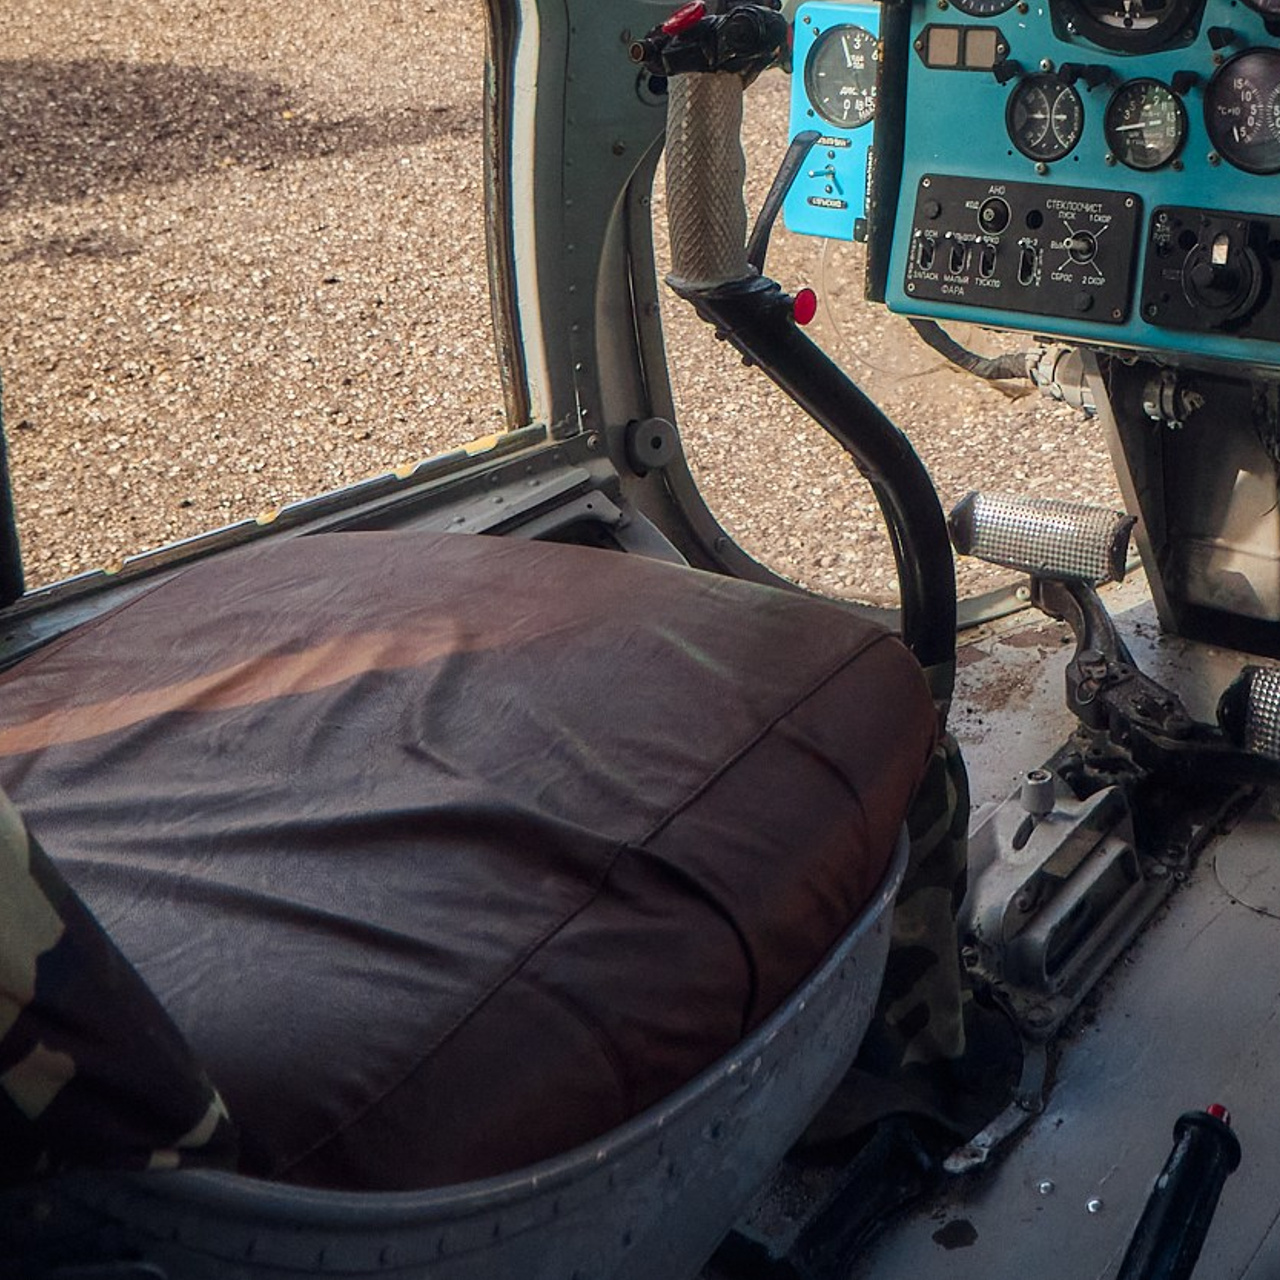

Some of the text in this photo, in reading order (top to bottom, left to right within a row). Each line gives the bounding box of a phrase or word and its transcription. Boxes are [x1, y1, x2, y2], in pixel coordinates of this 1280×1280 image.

[854, 38, 861, 50] 3
[871, 49, 879, 61] 6
[1234, 79, 1244, 90] 15
[1140, 95, 1146, 104] 7
[1153, 95, 1160, 106] 9
[1241, 91, 1251, 102] 10
[843, 99, 850, 110] 0
[1130, 101, 1136, 111] 5
[1161, 102, 1167, 111] 11
[1250, 104, 1257, 115] 5
[1124, 110, 1130, 120] 3
[1274, 105, 1280, 116] 5
[1167, 112, 1176, 121] 13
[1247, 116, 1254, 127] 0
[1166, 126, 1176, 137] 15
[988, 185, 1005, 195] АНО
[1046, 199, 1103, 213] СТЕКЛООЧИСТ
[1058, 211, 1077, 220] ПУСК
[1094, 215, 1112, 223] СКОР
[943, 275, 969, 284] МАЛЫЙ
[1051, 272, 1073, 282] СБРОС
[1088, 276, 1106, 285] СКОР
[941, 285, 964, 296] ФАРА
